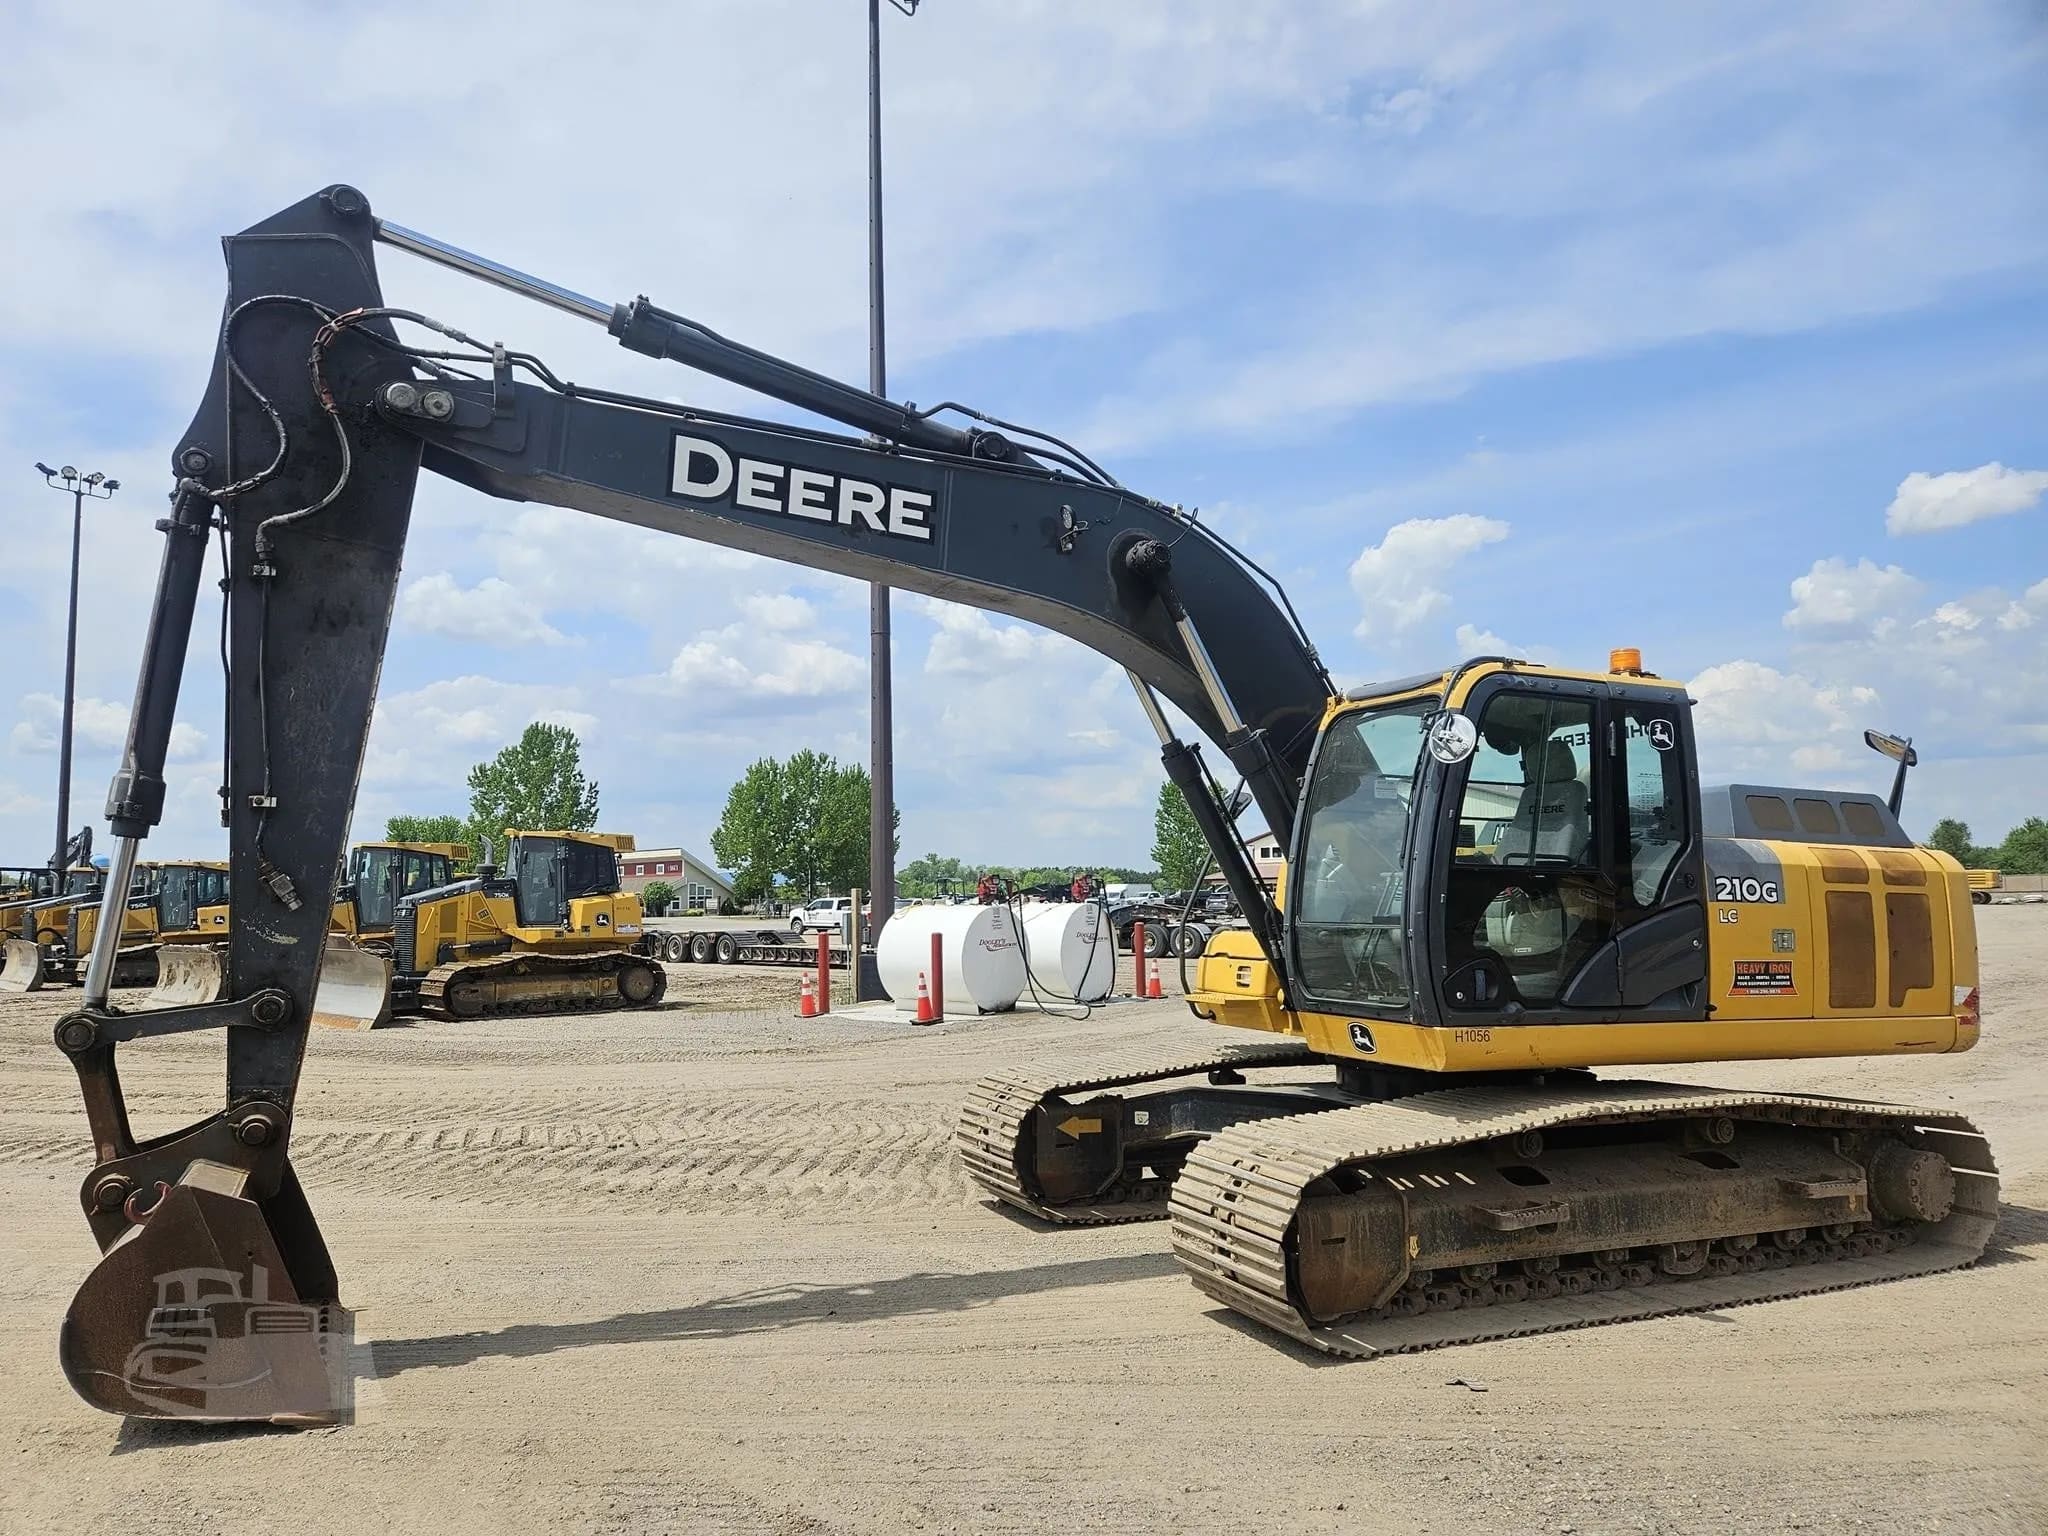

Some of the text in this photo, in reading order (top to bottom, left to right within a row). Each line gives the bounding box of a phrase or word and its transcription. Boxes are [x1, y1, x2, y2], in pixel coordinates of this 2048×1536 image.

[672, 435, 932, 539] DEERE
[1714, 876, 1778, 903] 210G
[1719, 909, 1738, 923] LC
[1736, 963, 1791, 974] HEAVY IRON
[1455, 1029, 1491, 1043] H1056
